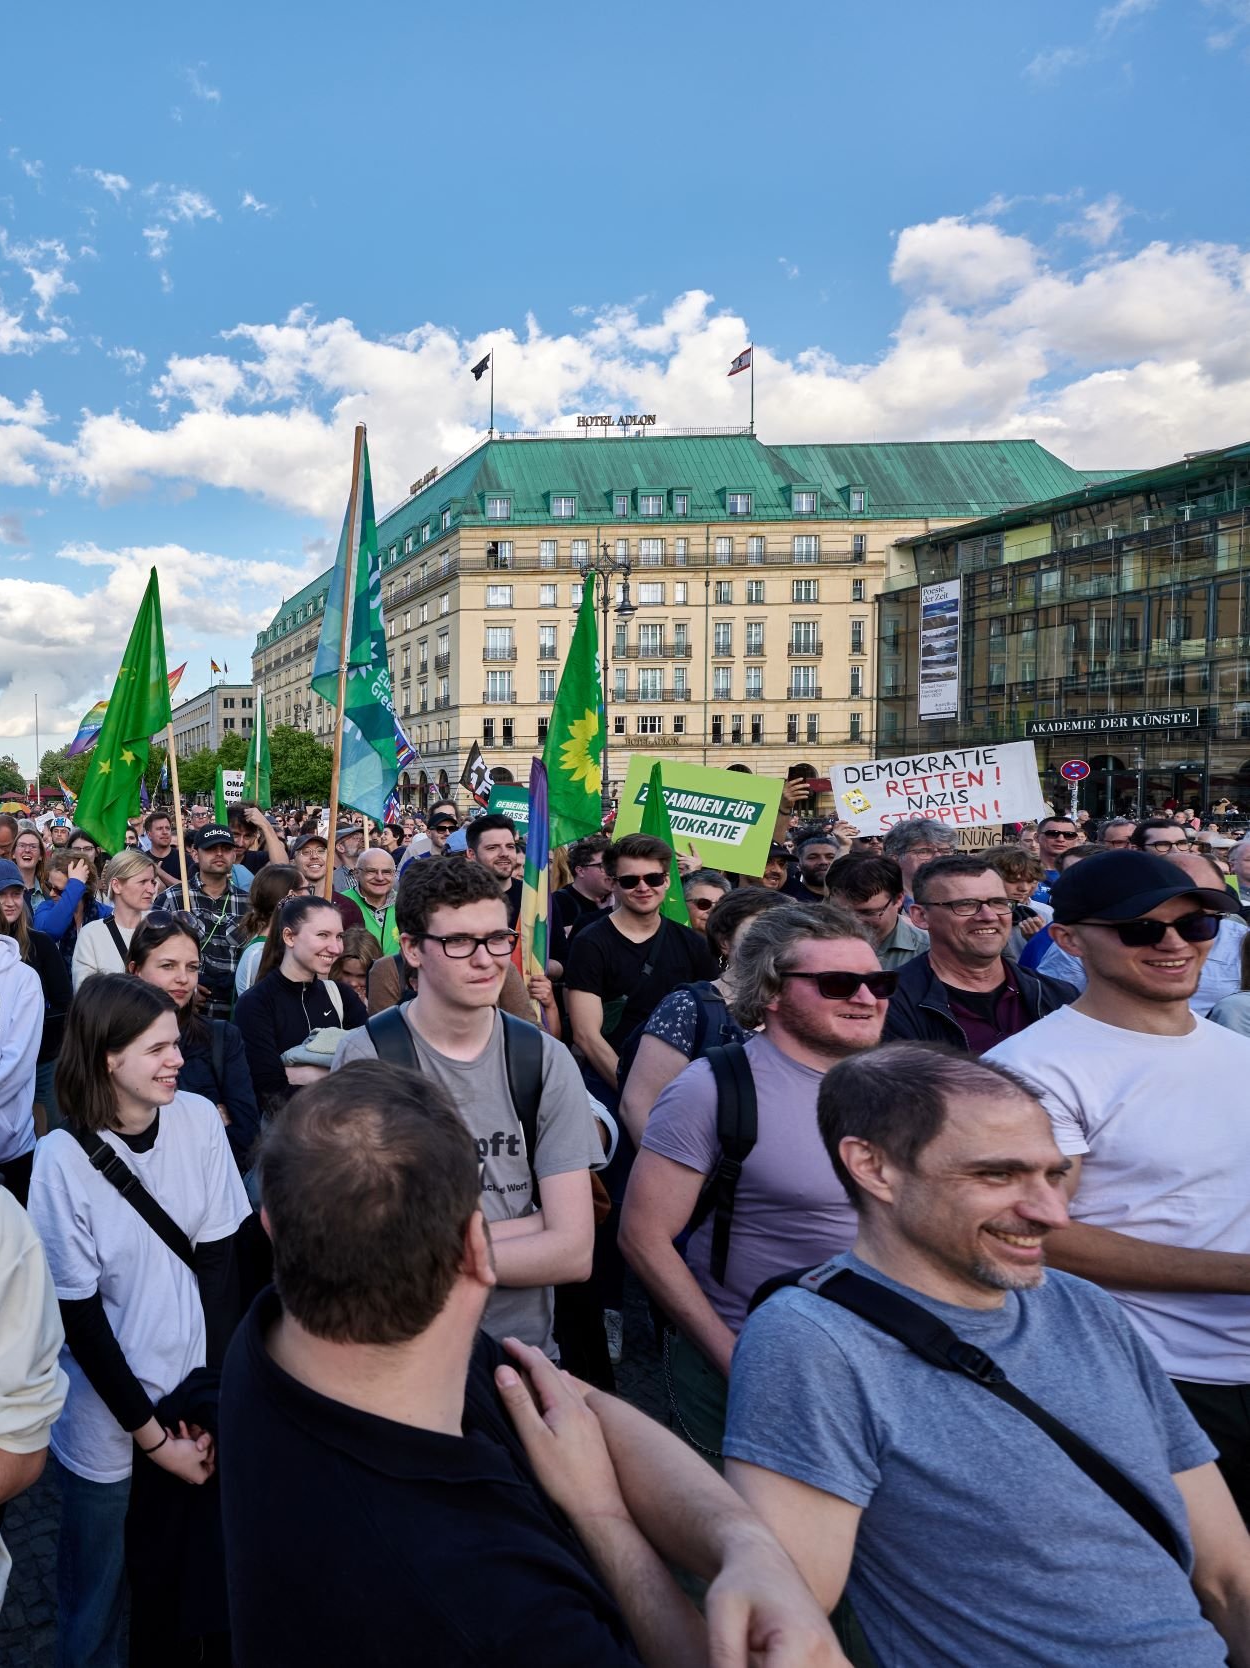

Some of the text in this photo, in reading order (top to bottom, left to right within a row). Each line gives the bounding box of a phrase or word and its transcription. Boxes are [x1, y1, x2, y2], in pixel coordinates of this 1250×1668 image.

[577, 415, 656, 427] HOTEL ADLON
[923, 586, 945, 596] Poesie
[923, 592, 948, 603] der Zeit
[1031, 712, 1191, 733] AKADEMIE DER KÜNSTE
[844, 748, 997, 784] DEMOKRATIE
[886, 766, 1001, 798] RETTEN !
[496, 800, 529, 811] GEMEINS
[639, 787, 756, 821] ZSAMMEN FÜR
[908, 789, 969, 811] NAZIS
[504, 811, 523, 820] HASS
[994, 799, 1002, 819] !
[204, 829, 231, 838] adidas
[958, 830, 1003, 846] INUNG
[506, 1182, 528, 1193] Wort
